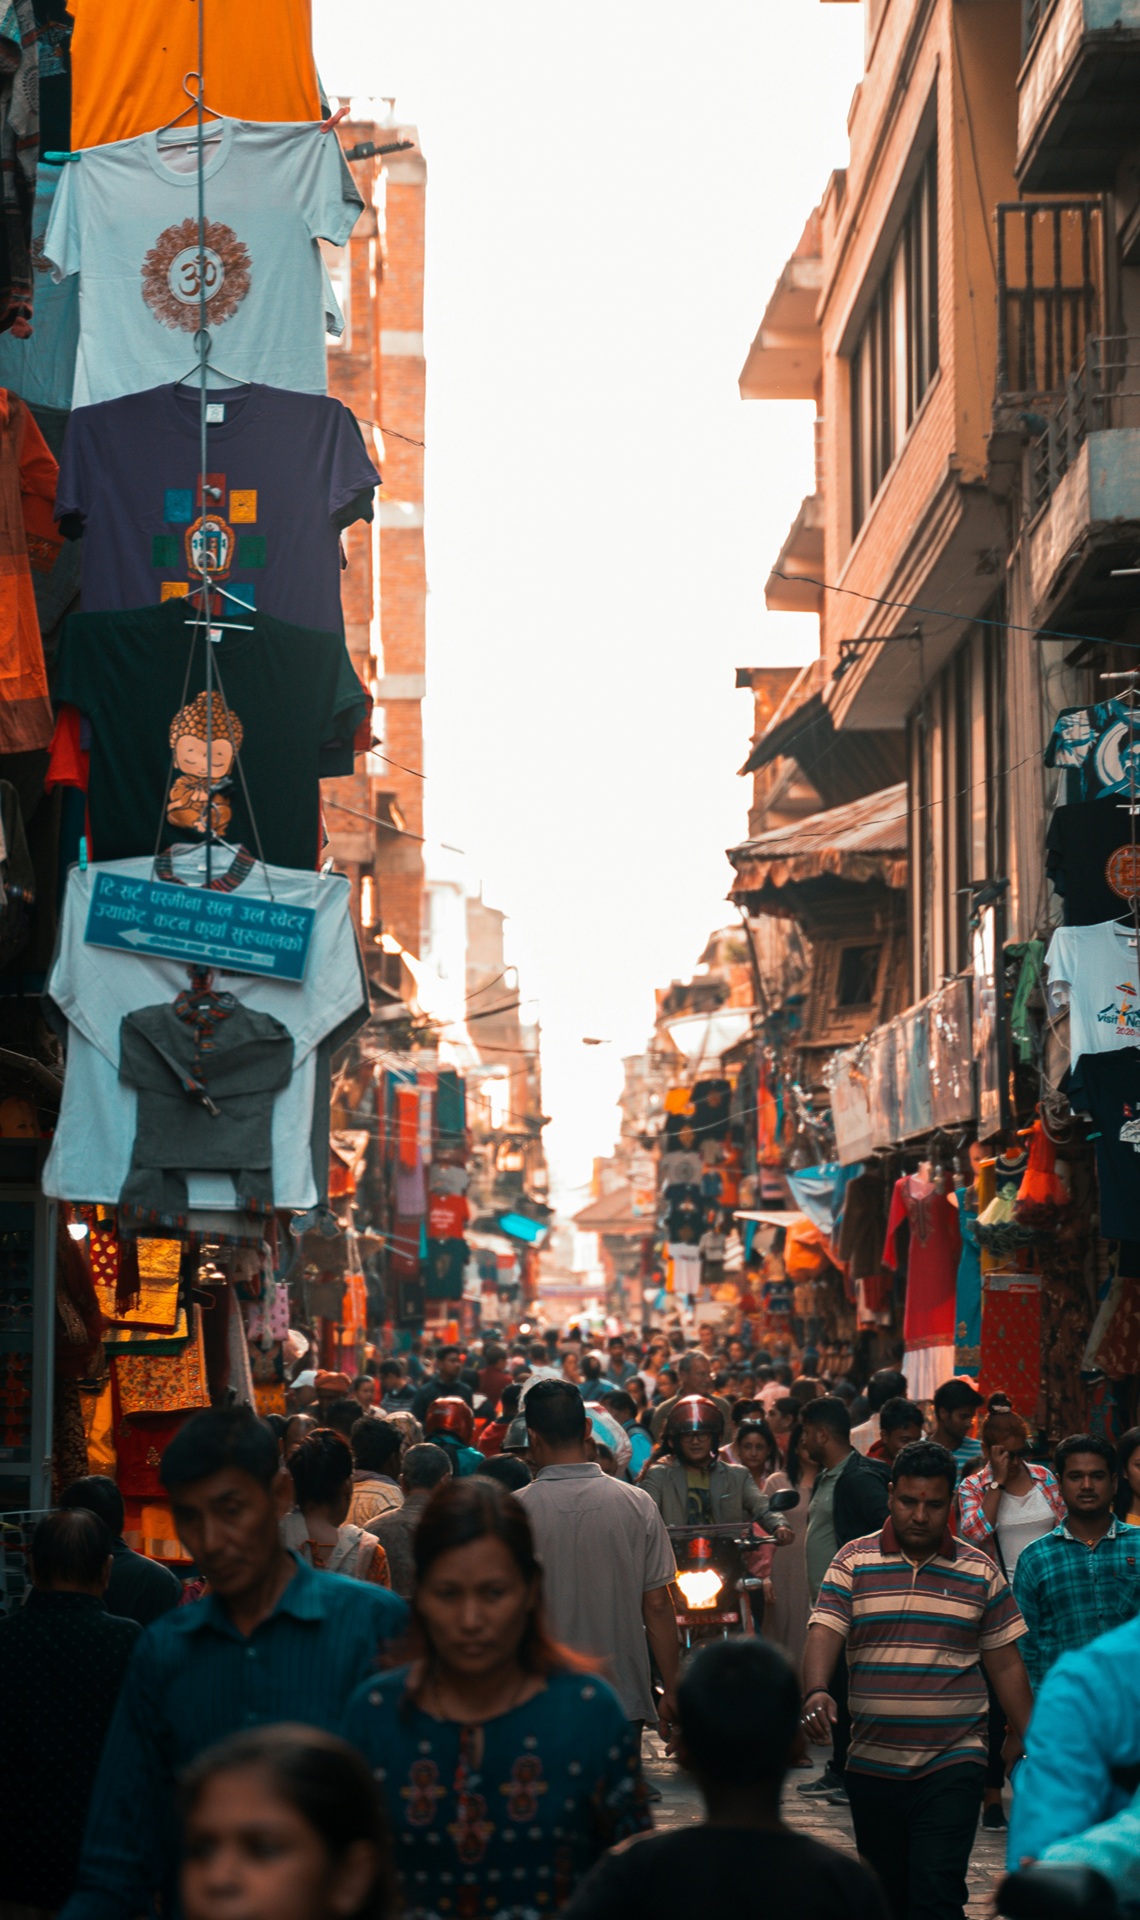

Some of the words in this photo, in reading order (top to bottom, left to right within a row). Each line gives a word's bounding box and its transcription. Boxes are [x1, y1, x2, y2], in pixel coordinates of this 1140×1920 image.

[153, 913, 192, 932] कटन
[241, 905, 266, 923] उल
[1116, 1027, 1136, 1036] 2020
